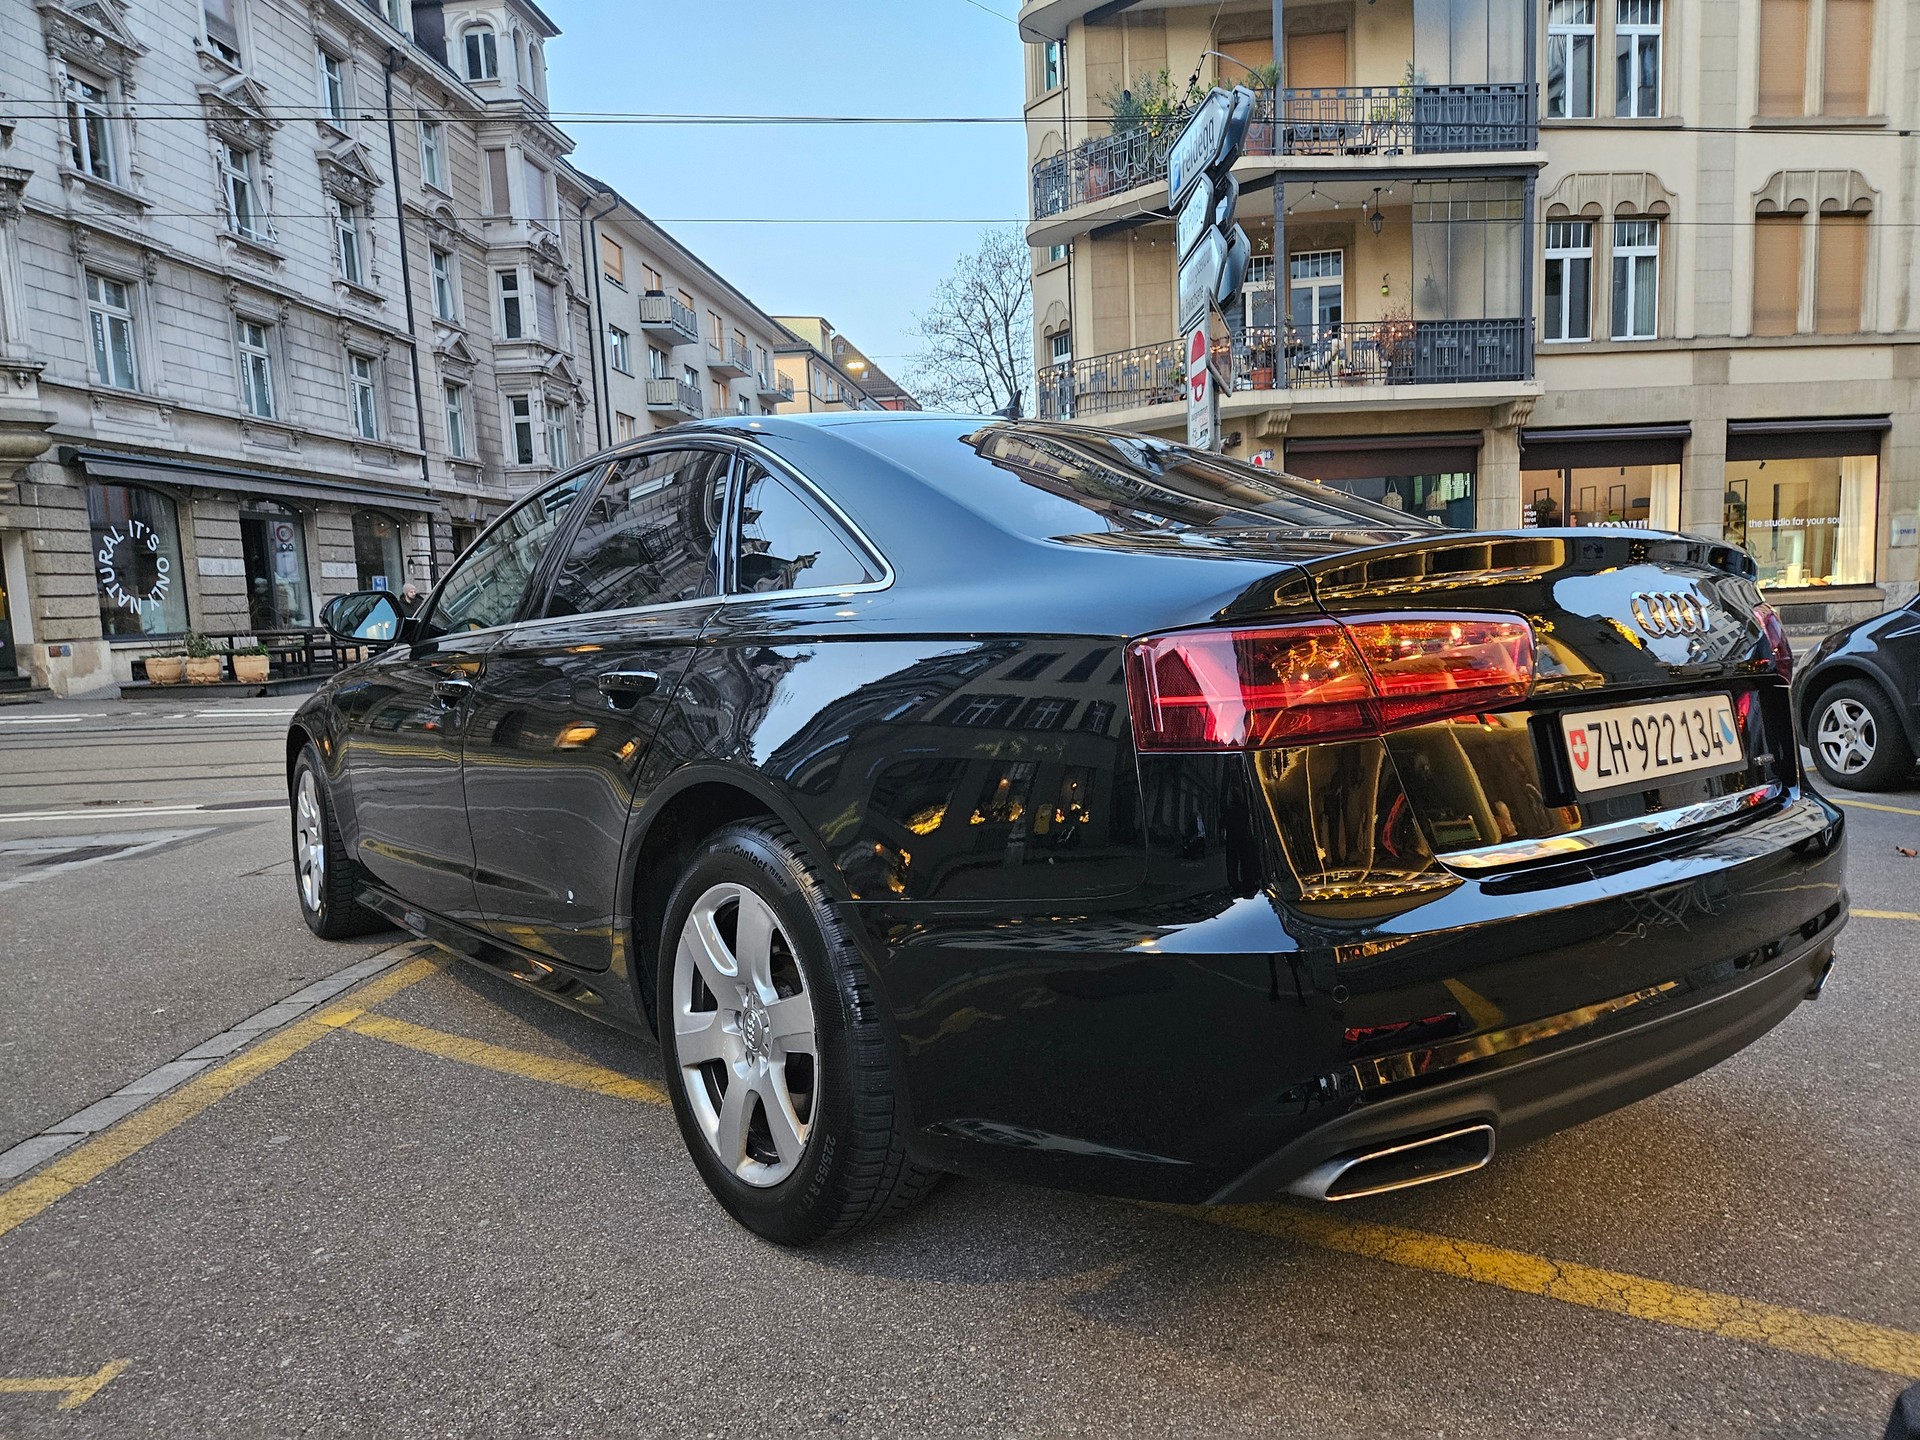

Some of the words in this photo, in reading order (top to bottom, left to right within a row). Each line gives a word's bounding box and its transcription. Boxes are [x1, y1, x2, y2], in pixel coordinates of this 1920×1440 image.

[129, 520, 160, 551] IT'S
[1749, 519, 1762, 528] the
[1764, 517, 1790, 527] studio
[1792, 516, 1805, 526] for
[1806, 517, 1825, 527] your
[99, 525, 142, 615] NATURAL
[148, 557, 170, 611] ONLY
